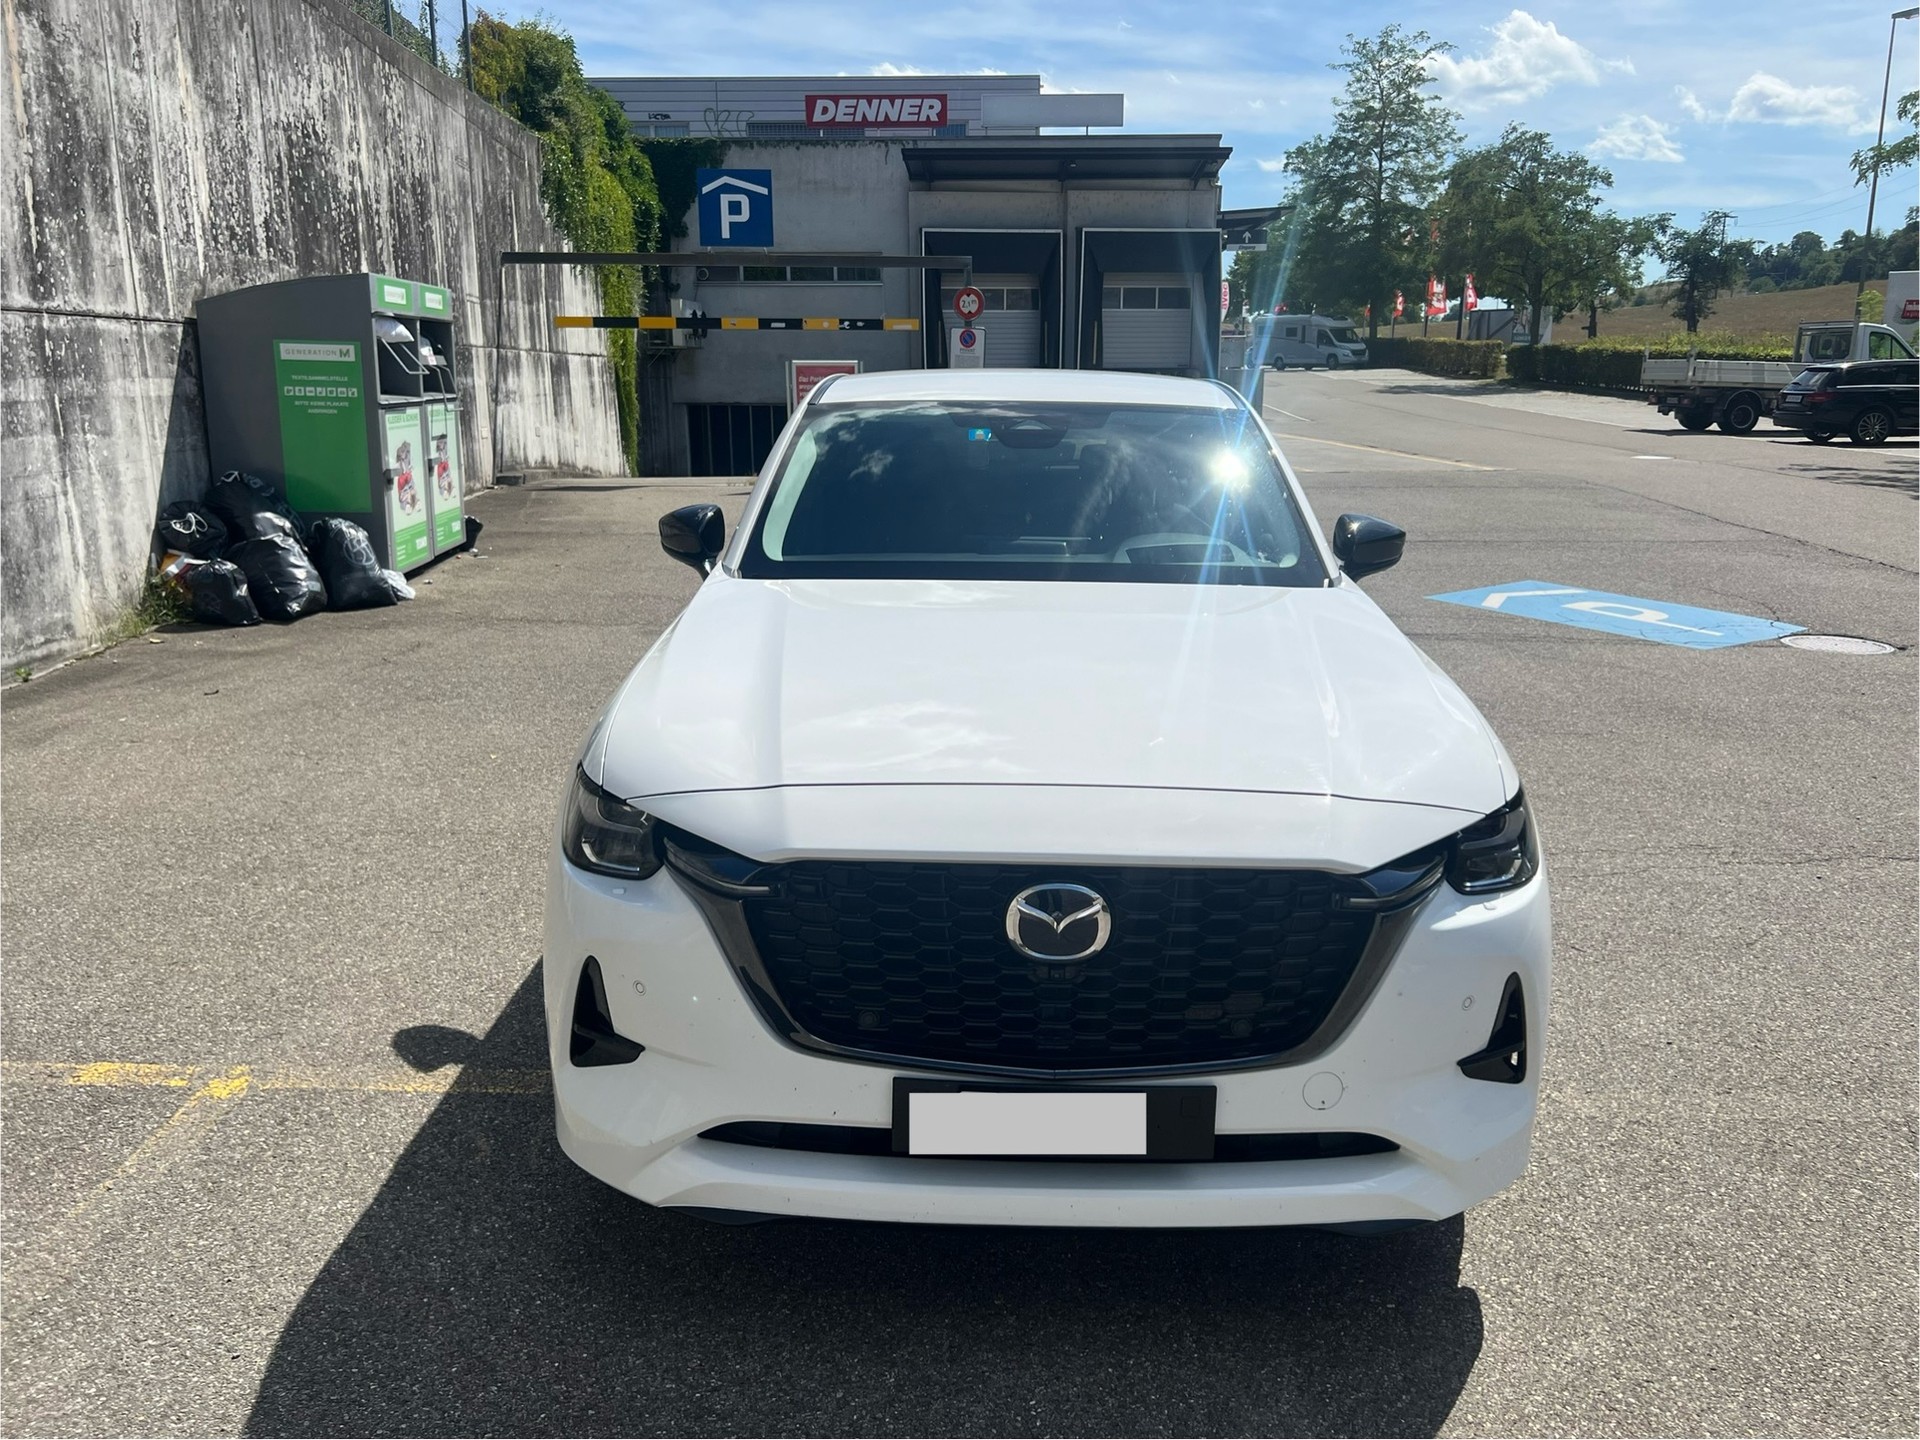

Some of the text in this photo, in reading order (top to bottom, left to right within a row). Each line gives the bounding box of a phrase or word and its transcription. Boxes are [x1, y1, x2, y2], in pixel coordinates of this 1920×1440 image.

[812, 98, 942, 123] DENNER
[720, 193, 750, 239] P
[284, 348, 337, 357] GENERATION
